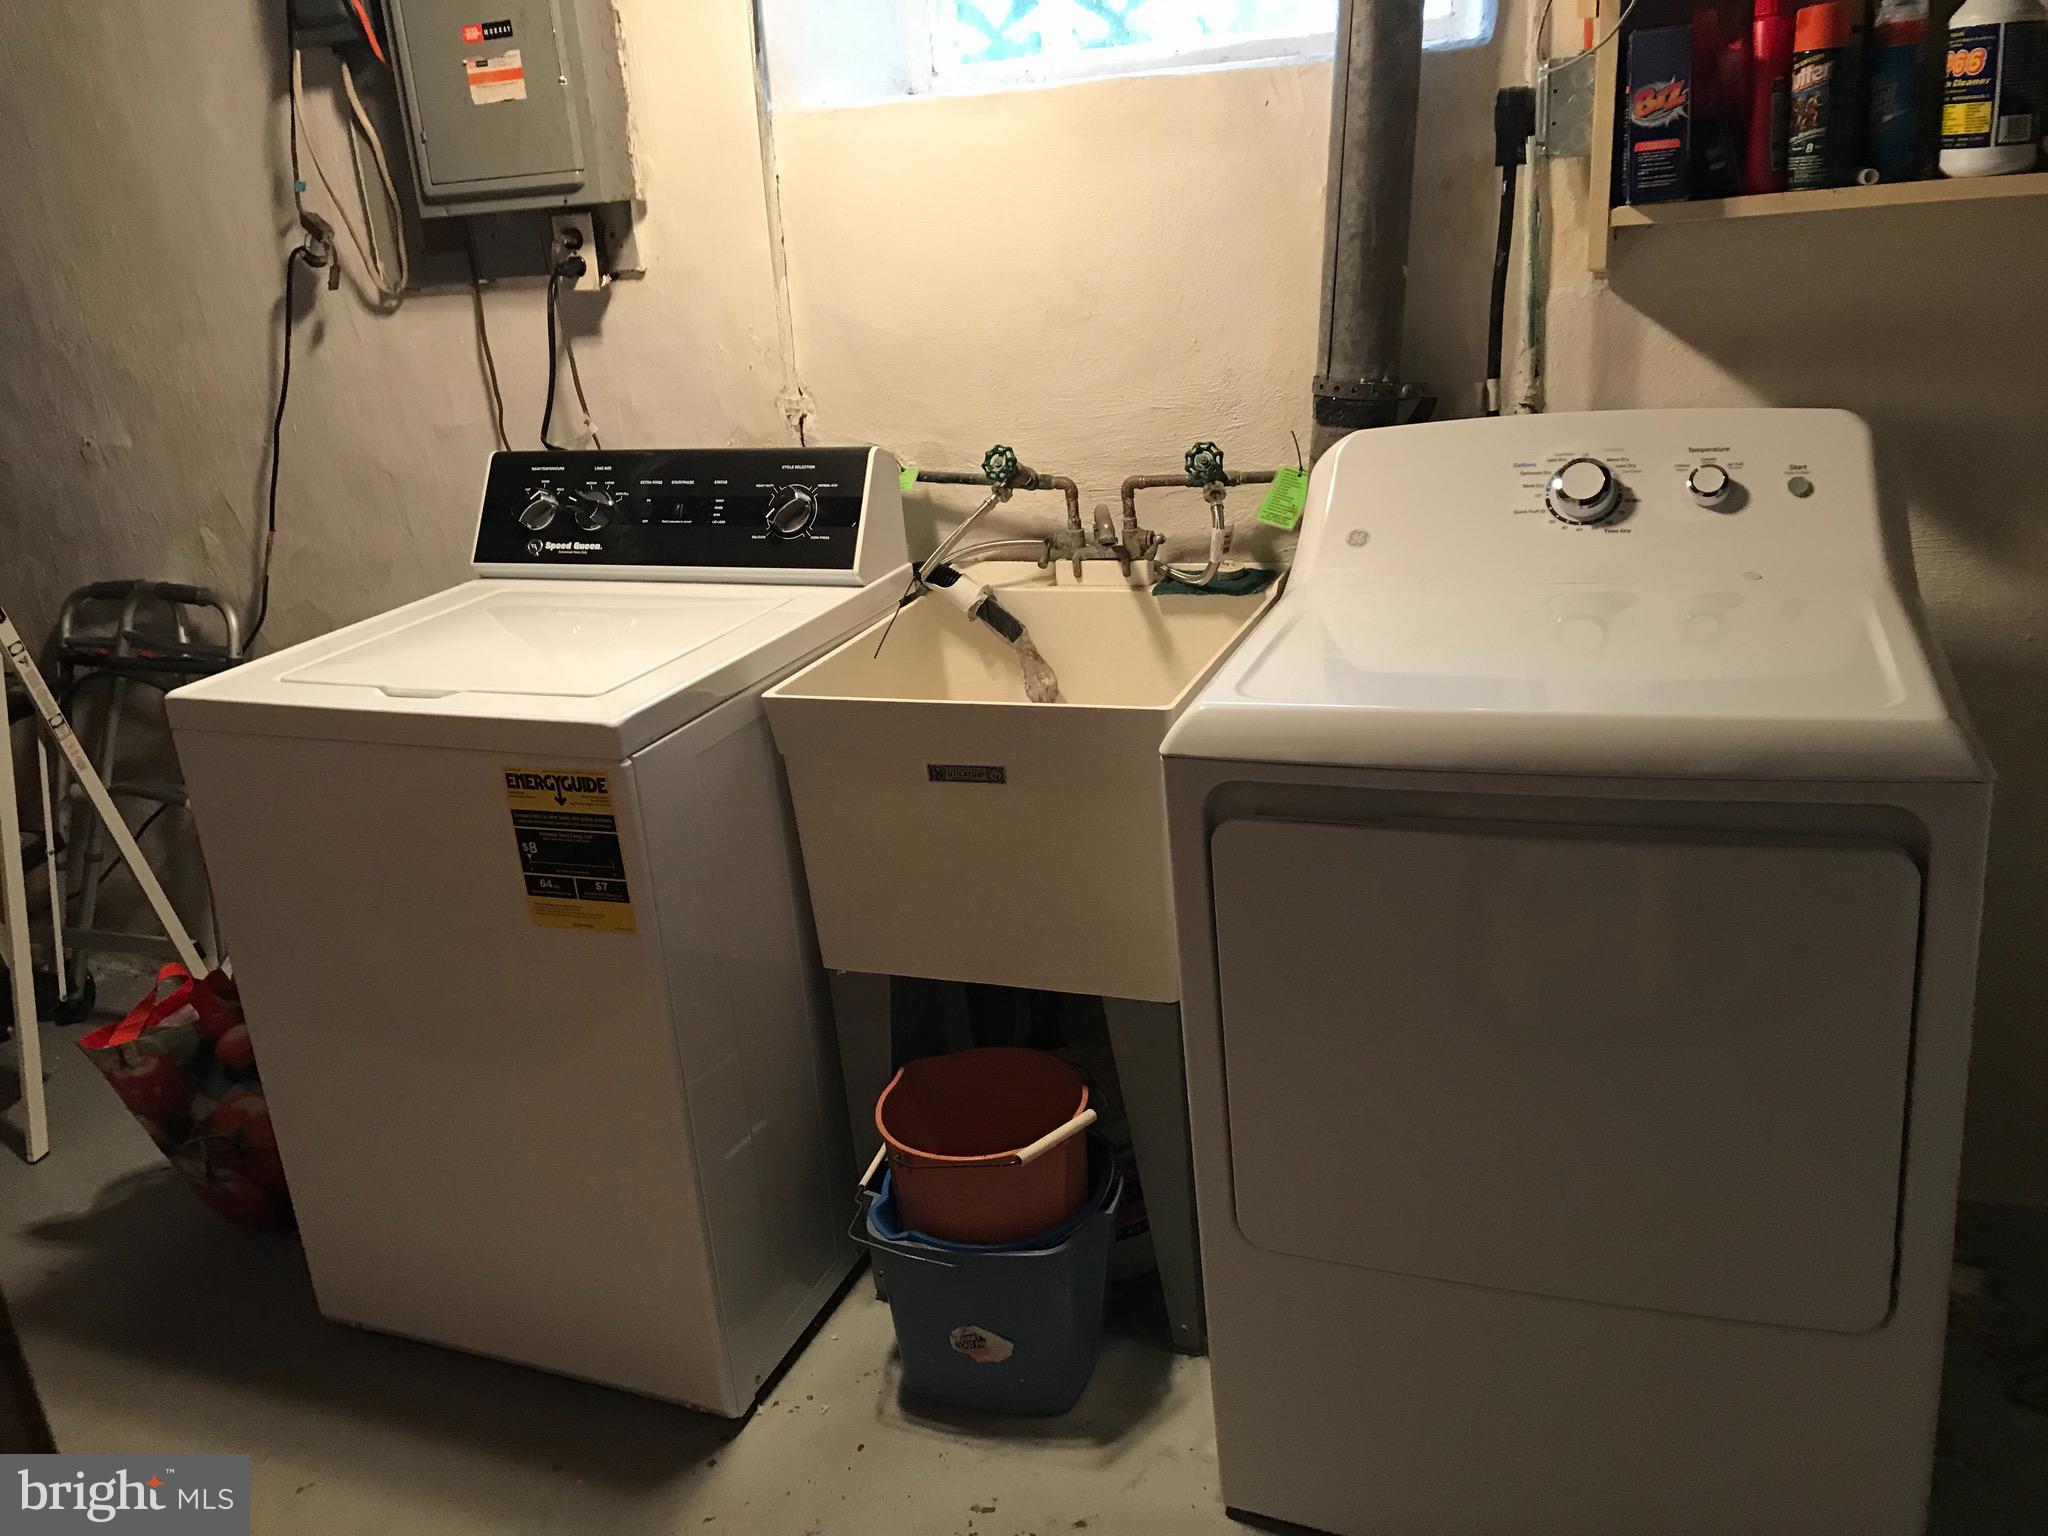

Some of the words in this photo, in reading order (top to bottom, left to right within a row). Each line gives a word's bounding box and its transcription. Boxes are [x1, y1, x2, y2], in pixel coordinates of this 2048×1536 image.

[545, 541, 572, 552] Speed
[522, 841, 538, 854] $8
[595, 881, 608, 892] $7
